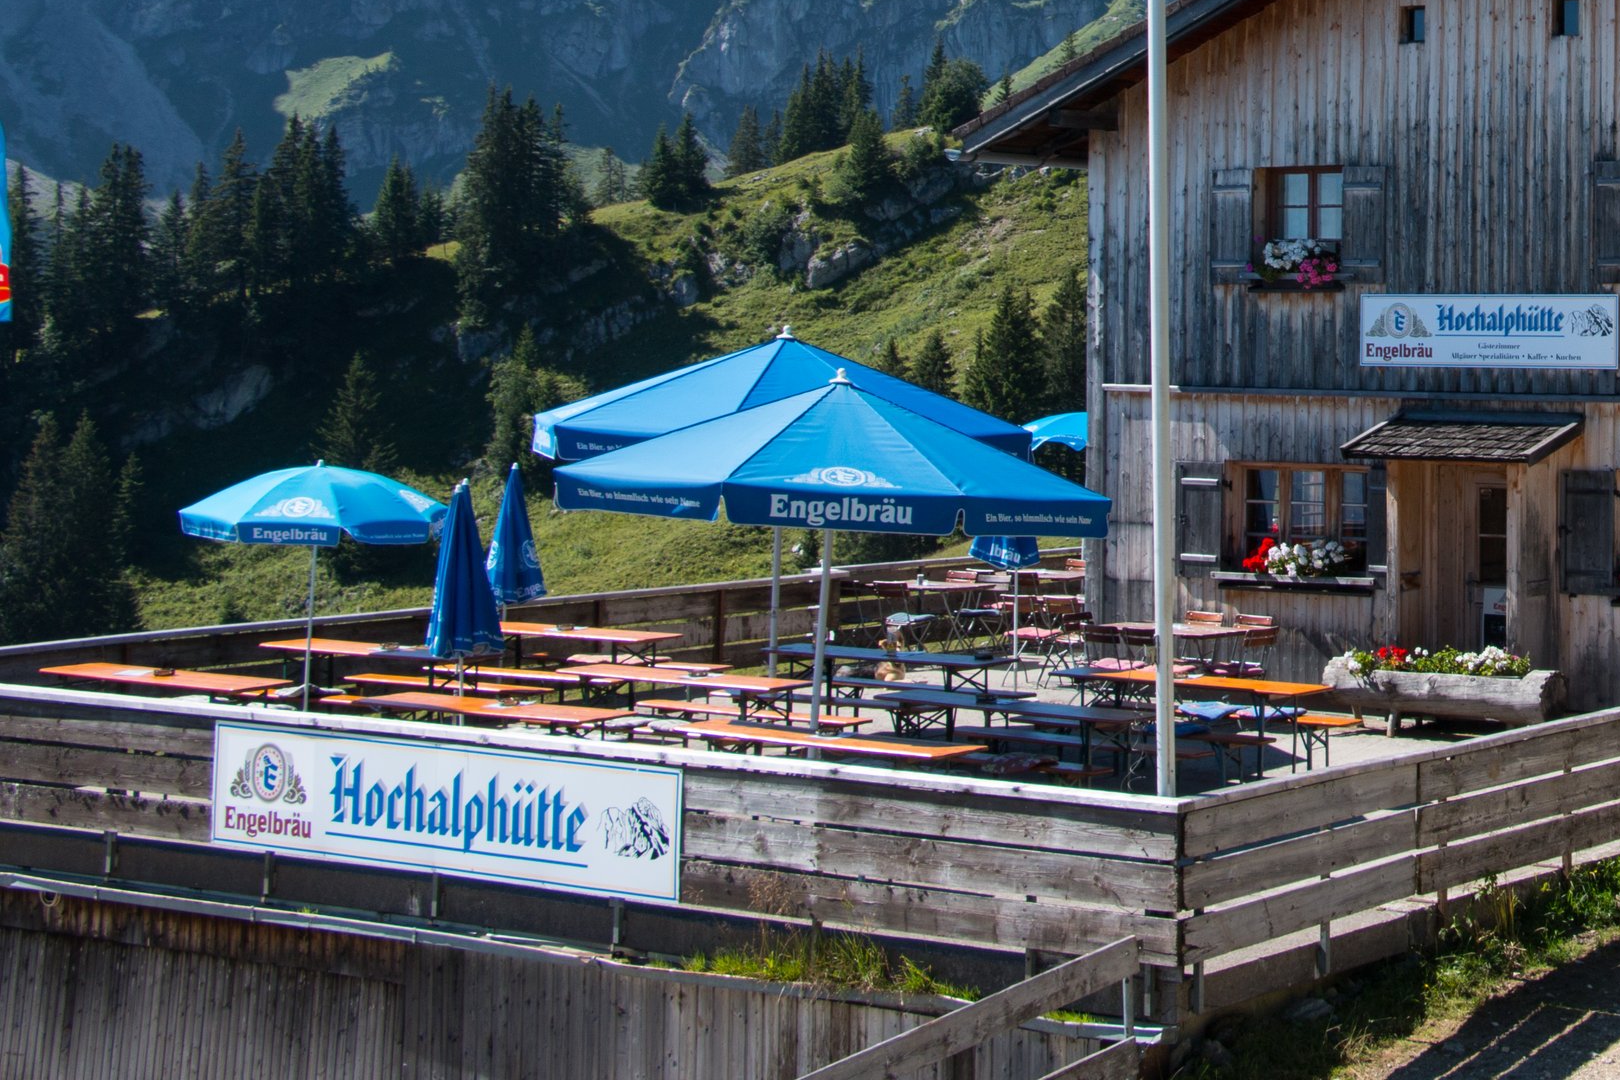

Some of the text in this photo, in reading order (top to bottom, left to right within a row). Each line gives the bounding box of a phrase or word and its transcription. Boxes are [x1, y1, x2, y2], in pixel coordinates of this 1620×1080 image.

[1436, 303, 1565, 336] Hochalphütte
[1366, 342, 1433, 361] Engelbräu
[769, 493, 913, 526] Engelbräu
[253, 527, 327, 543] Engelbräu
[330, 753, 588, 852] Hochalphütte
[224, 805, 311, 839] Engelbräu
